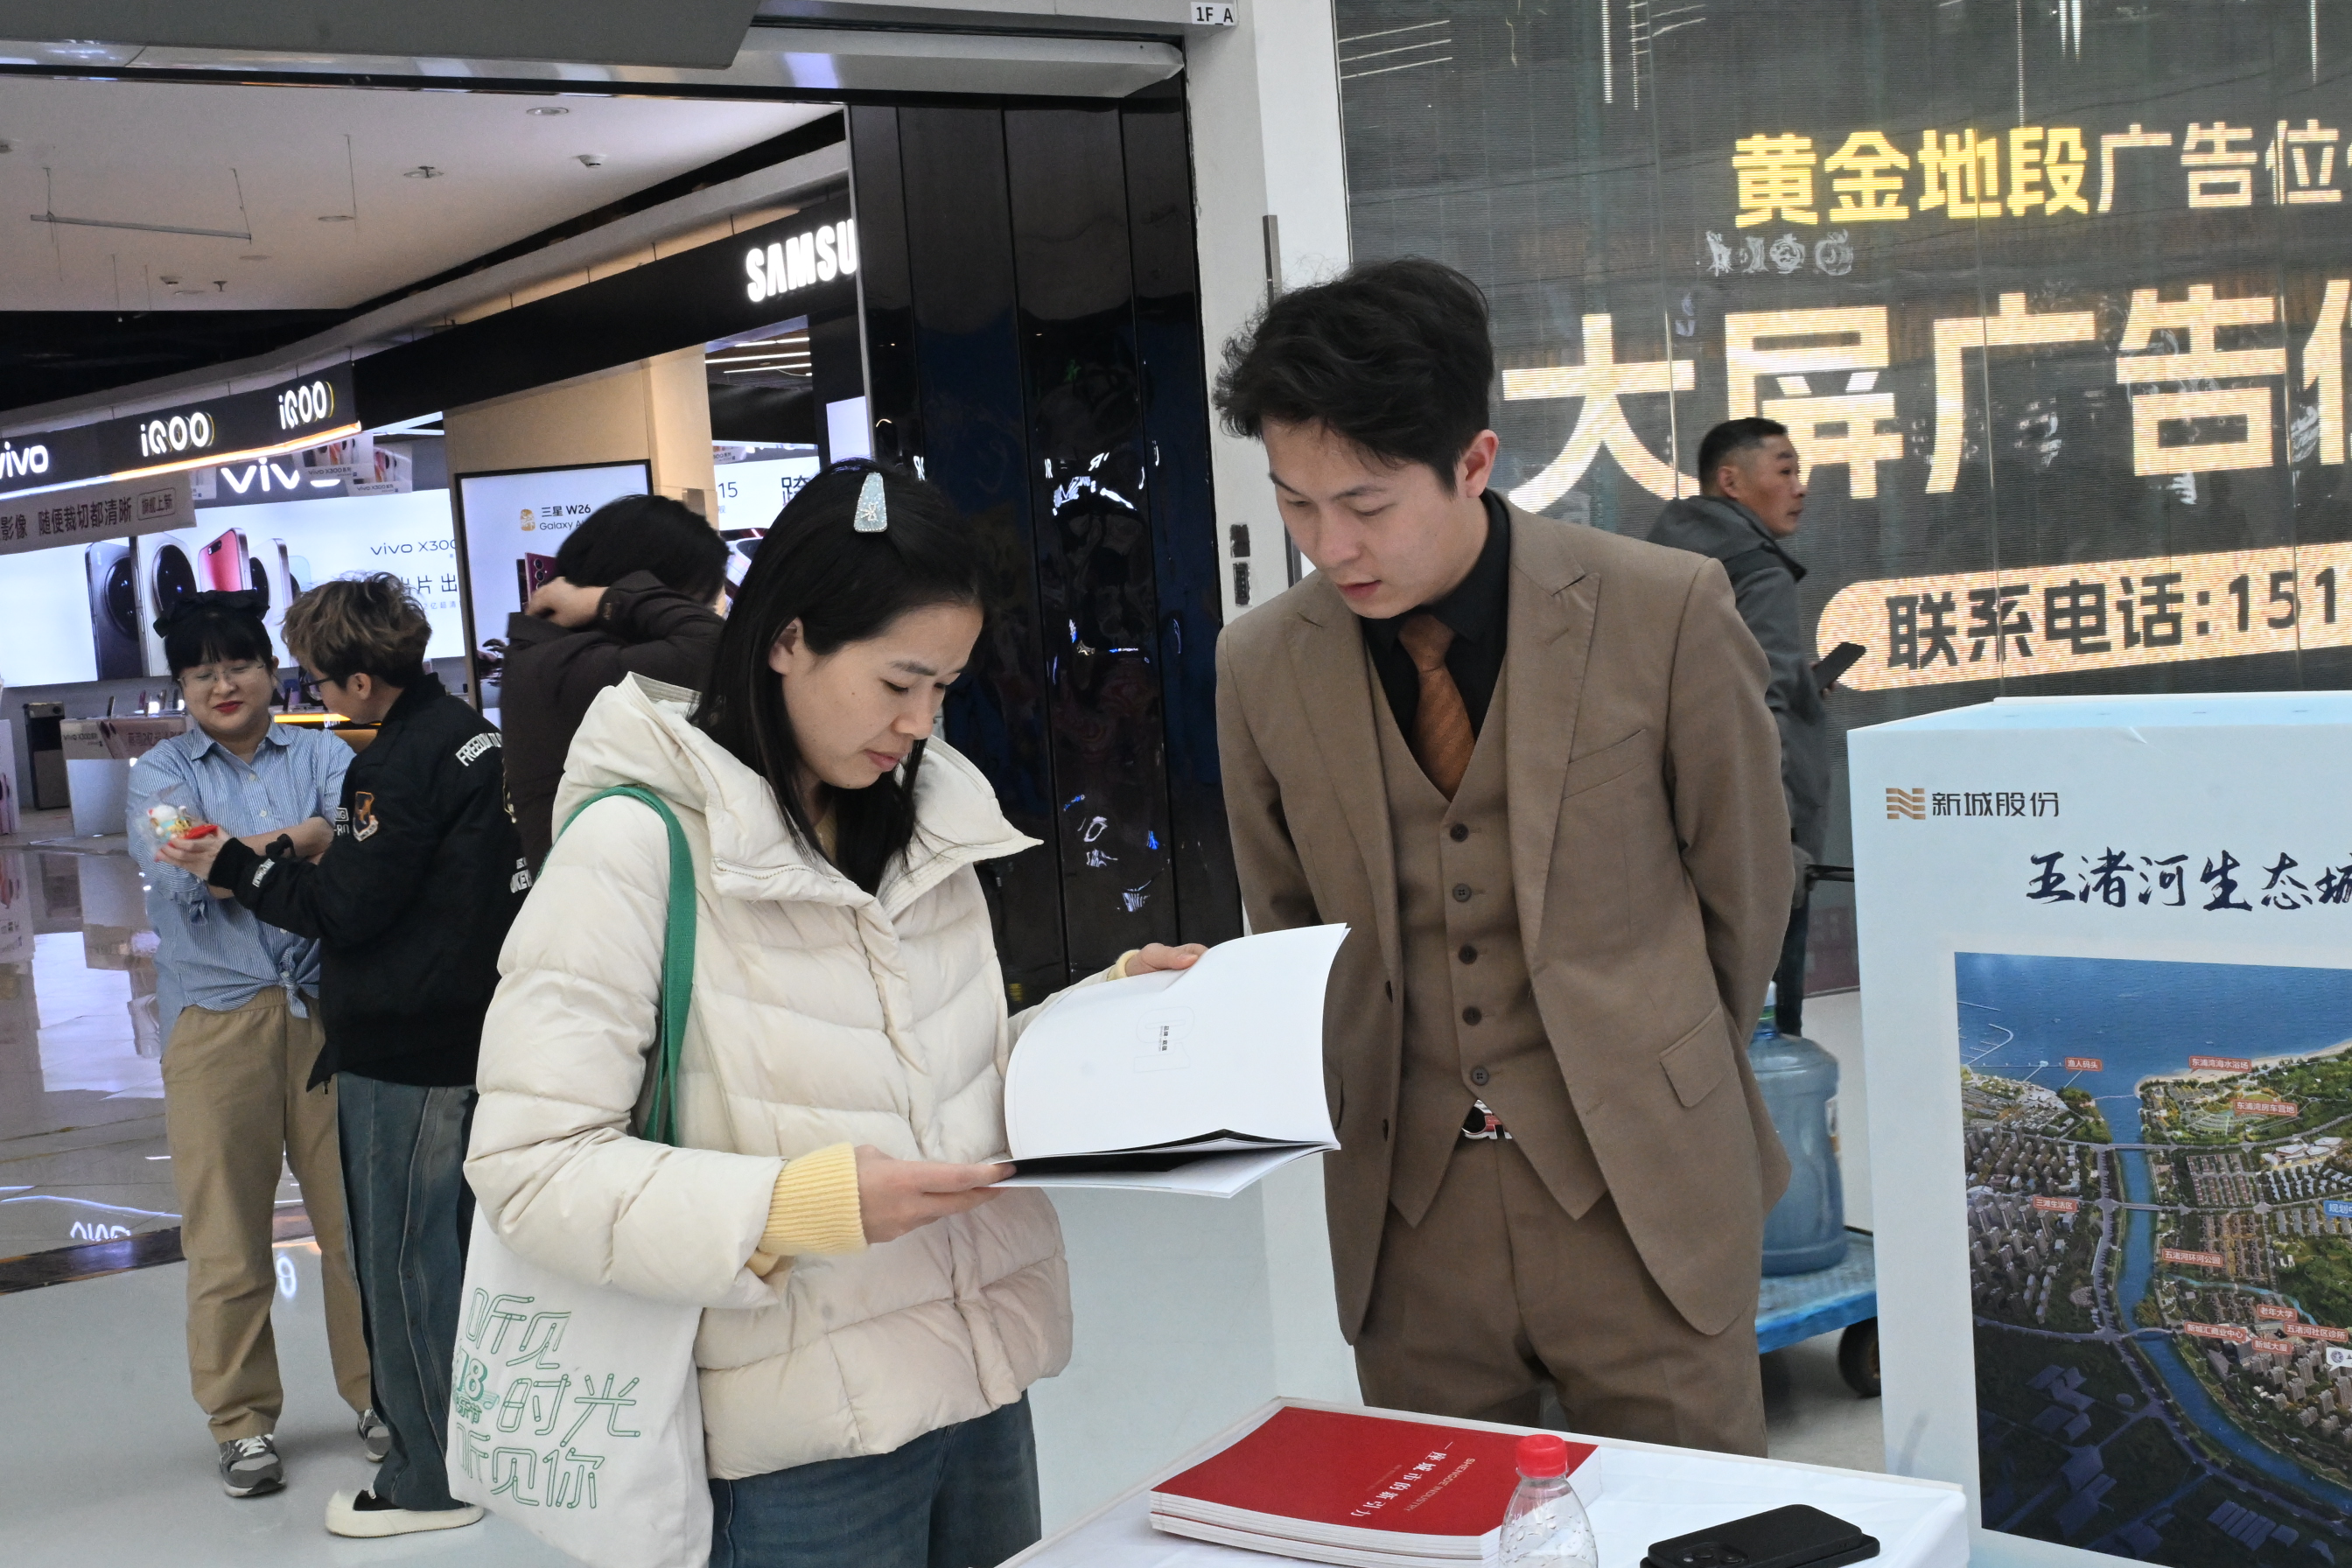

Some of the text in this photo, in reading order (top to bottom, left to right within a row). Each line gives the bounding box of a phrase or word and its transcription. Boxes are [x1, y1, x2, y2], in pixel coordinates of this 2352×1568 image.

[1732, 117, 2352, 228] 黄金地段广告位
[746, 218, 858, 302] SAMSU
[278, 381, 328, 430] iQOO
[140, 411, 211, 458] iQOO
[0, 441, 50, 480] ivo
[220, 456, 341, 494] viv
[718, 481, 738, 499] 15
[38, 496, 132, 536] 随便裁切都清晰
[541, 504, 592, 517] 三星 W26
[539, 522, 573, 530] Galaxy
[370, 542, 413, 556] vivo
[1885, 567, 2337, 671] 联系电话:151
[1931, 791, 2060, 817] 新城股份
[2067, 1058, 2099, 1070] 渔人码头
[2191, 1057, 2250, 1071] 东浦湾海水浴场
[2236, 1101, 2295, 1115] 东浦湾房车营地
[2035, 1198, 2074, 1210] 三滩生活区
[2259, 1306, 2293, 1320] 老年大学
[1439, 1457, 1476, 1487] SHENGDE
